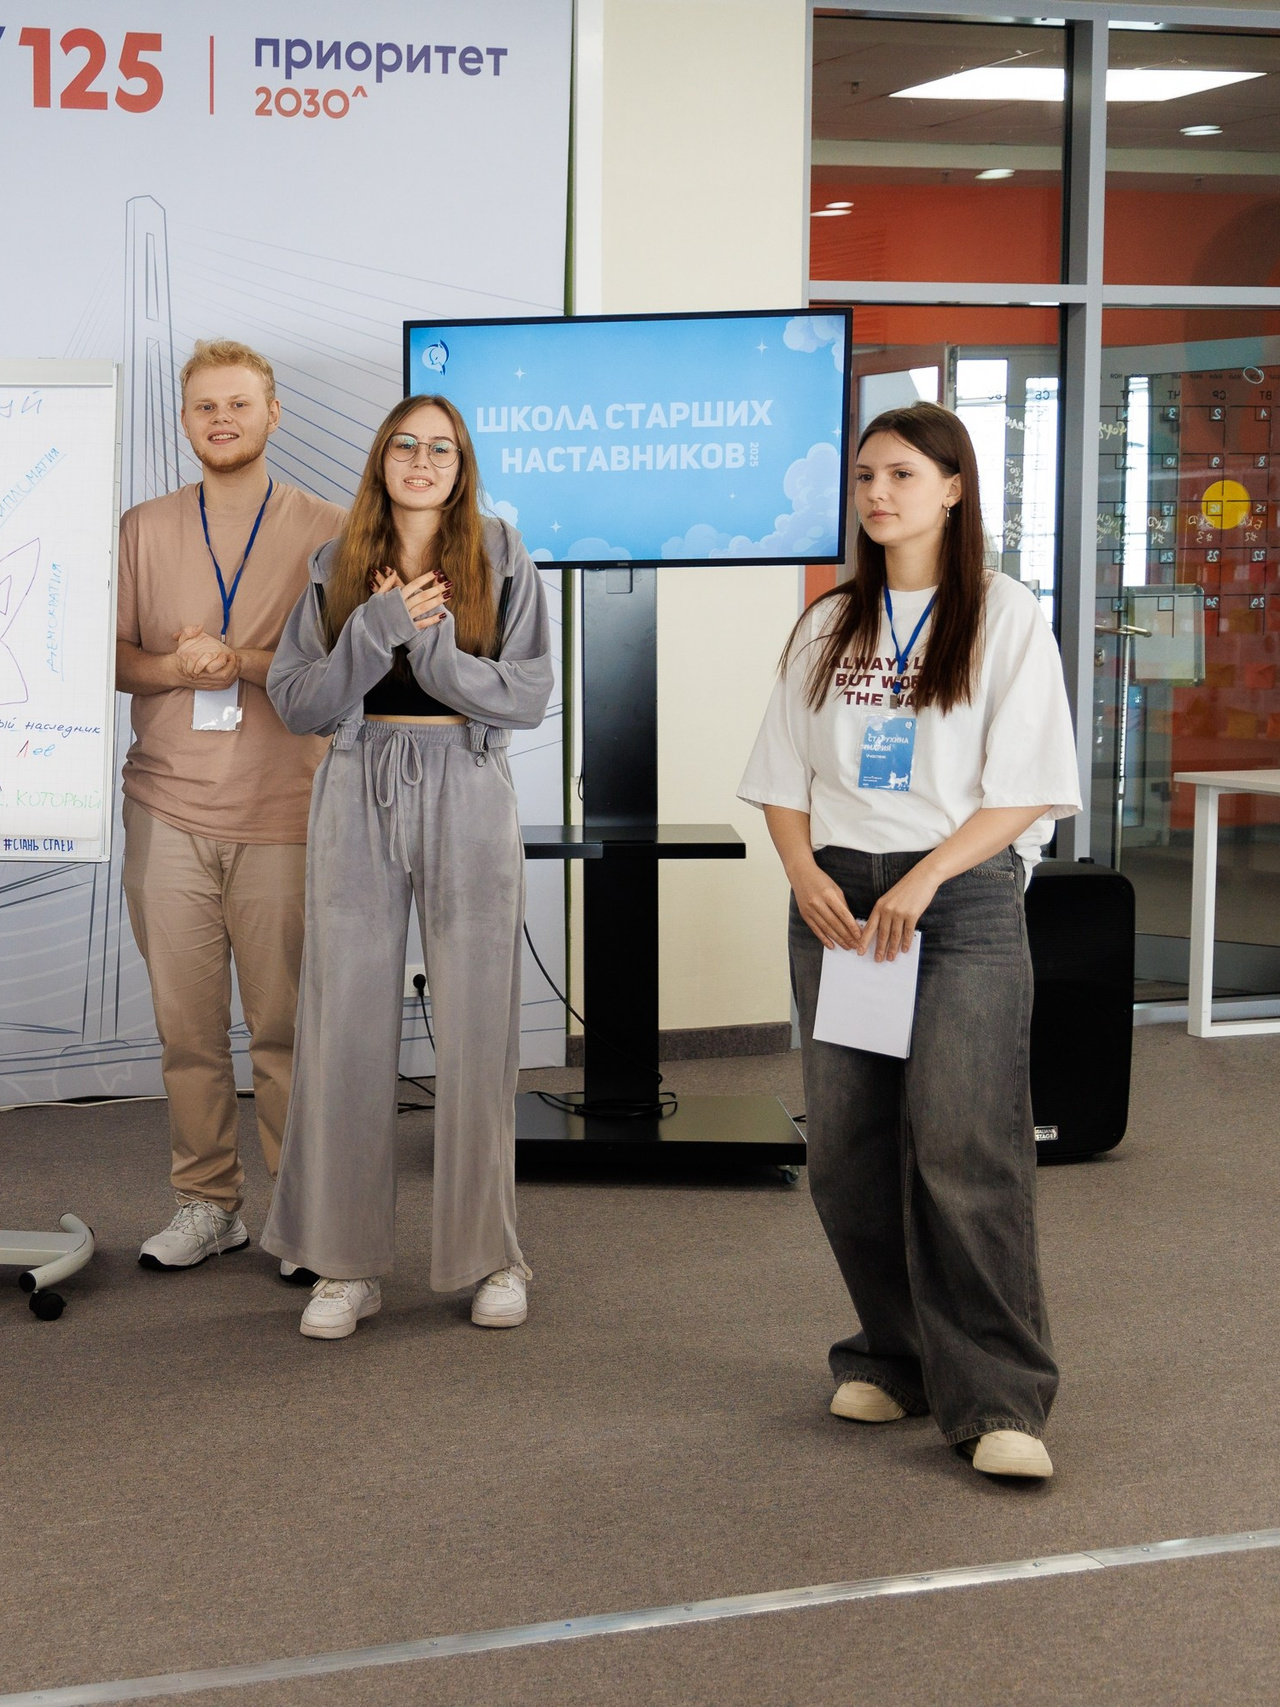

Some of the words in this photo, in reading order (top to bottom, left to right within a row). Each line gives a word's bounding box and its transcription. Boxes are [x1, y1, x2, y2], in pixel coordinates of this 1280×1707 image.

[18, 27, 165, 114] 125
[254, 37, 508, 83] приоритет
[476, 405, 599, 433] ШКОЛА
[606, 400, 773, 429] СТАРШИХ
[501, 442, 746, 474] НАСТАВНИКОВ
[750, 442, 760, 467] 2025
[835, 673, 875, 687] BUT
[843, 691, 884, 706] THE
[16, 740, 56, 758] Лев
